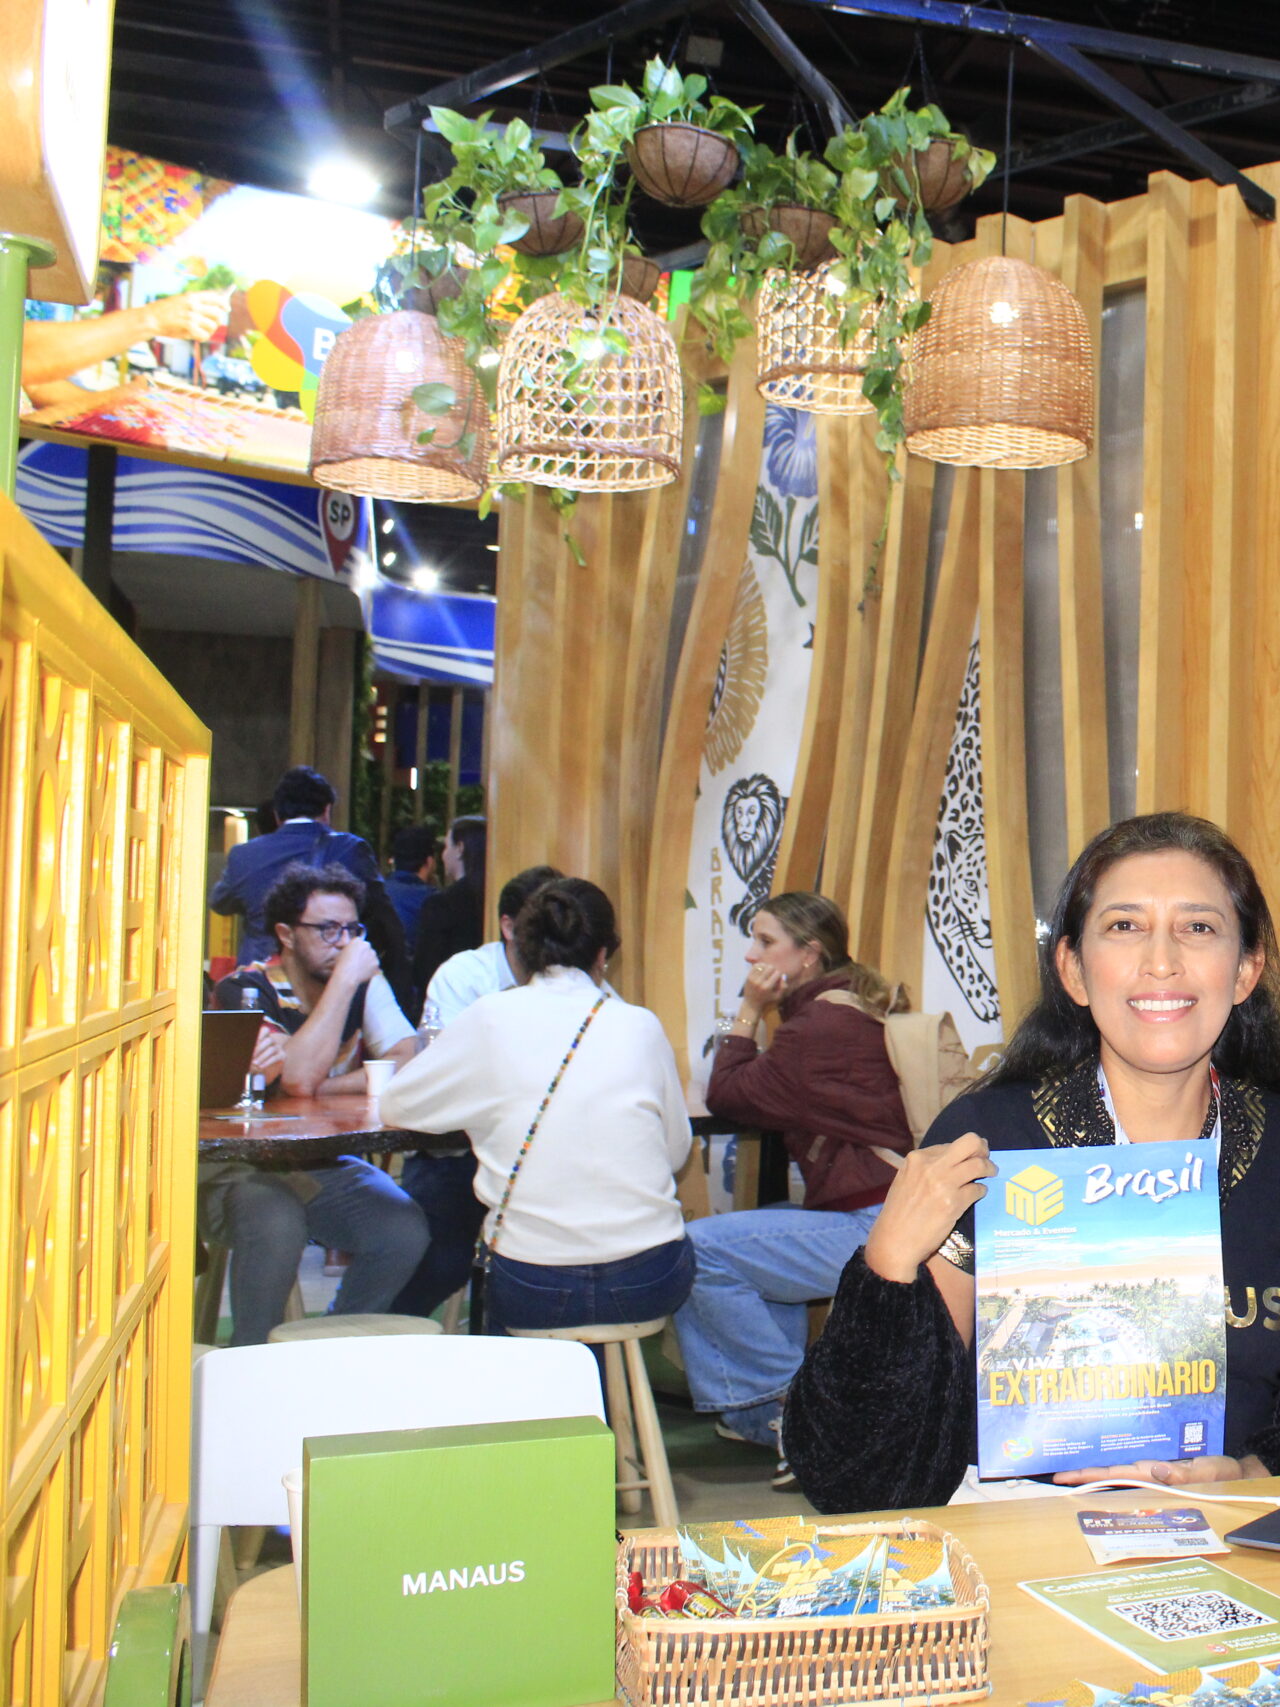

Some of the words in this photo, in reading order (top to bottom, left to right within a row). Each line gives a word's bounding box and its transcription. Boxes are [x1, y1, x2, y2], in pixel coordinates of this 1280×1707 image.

[329, 500, 351, 524] SP
[711, 847, 724, 1020] BRASIL
[1082, 1152, 1204, 1204] Brasil
[989, 1358, 1217, 1407] EXTRAORDINARIO
[1104, 1527, 1187, 1535] EXPOSITOR
[402, 1559, 526, 1596] MANAUS
[1130, 1565, 1208, 1581] Manaus
